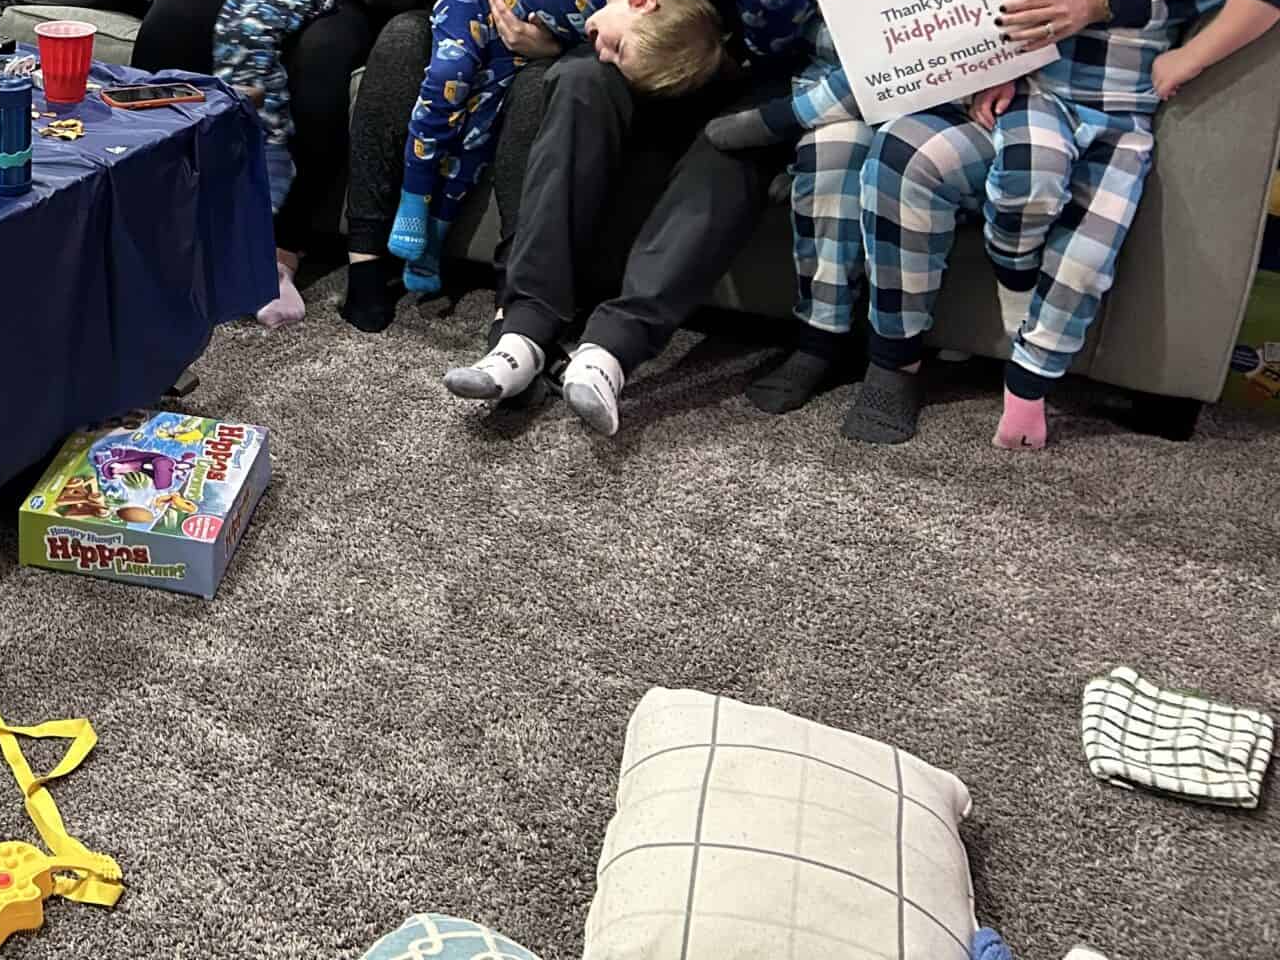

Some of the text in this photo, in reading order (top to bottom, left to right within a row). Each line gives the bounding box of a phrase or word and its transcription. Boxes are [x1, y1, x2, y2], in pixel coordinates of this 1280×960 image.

[865, 72, 892, 86] We
[894, 58, 924, 79] had
[928, 56, 947, 68] so
[951, 39, 997, 61] much
[877, 87, 894, 101] at
[896, 80, 921, 95] our
[926, 69, 952, 86] Get
[205, 425, 244, 481] Hippos
[47, 536, 149, 569] Hippos
